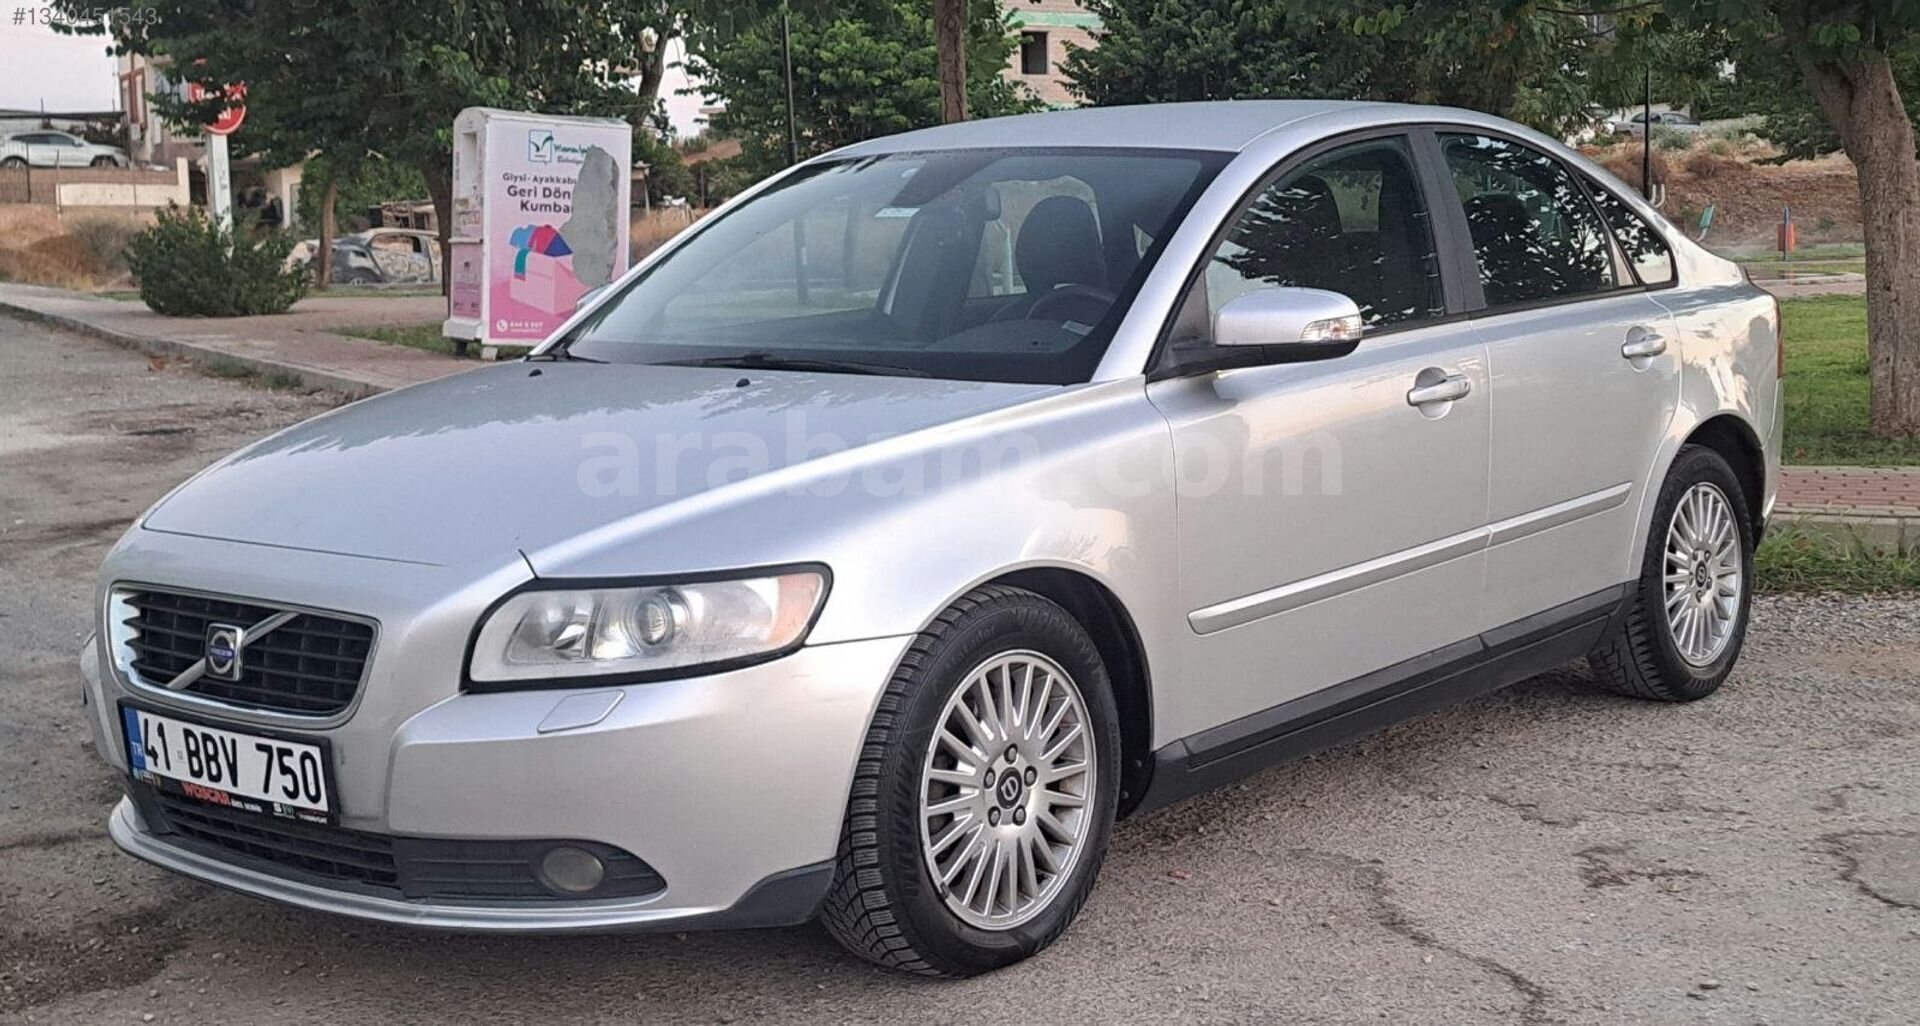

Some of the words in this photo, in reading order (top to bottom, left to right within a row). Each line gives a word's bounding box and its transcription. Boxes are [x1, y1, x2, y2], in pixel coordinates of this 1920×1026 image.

[507, 184, 538, 198] Geri
[143, 718, 171, 771] 41
[183, 727, 239, 788] BBV
[255, 742, 322, 804] 750
